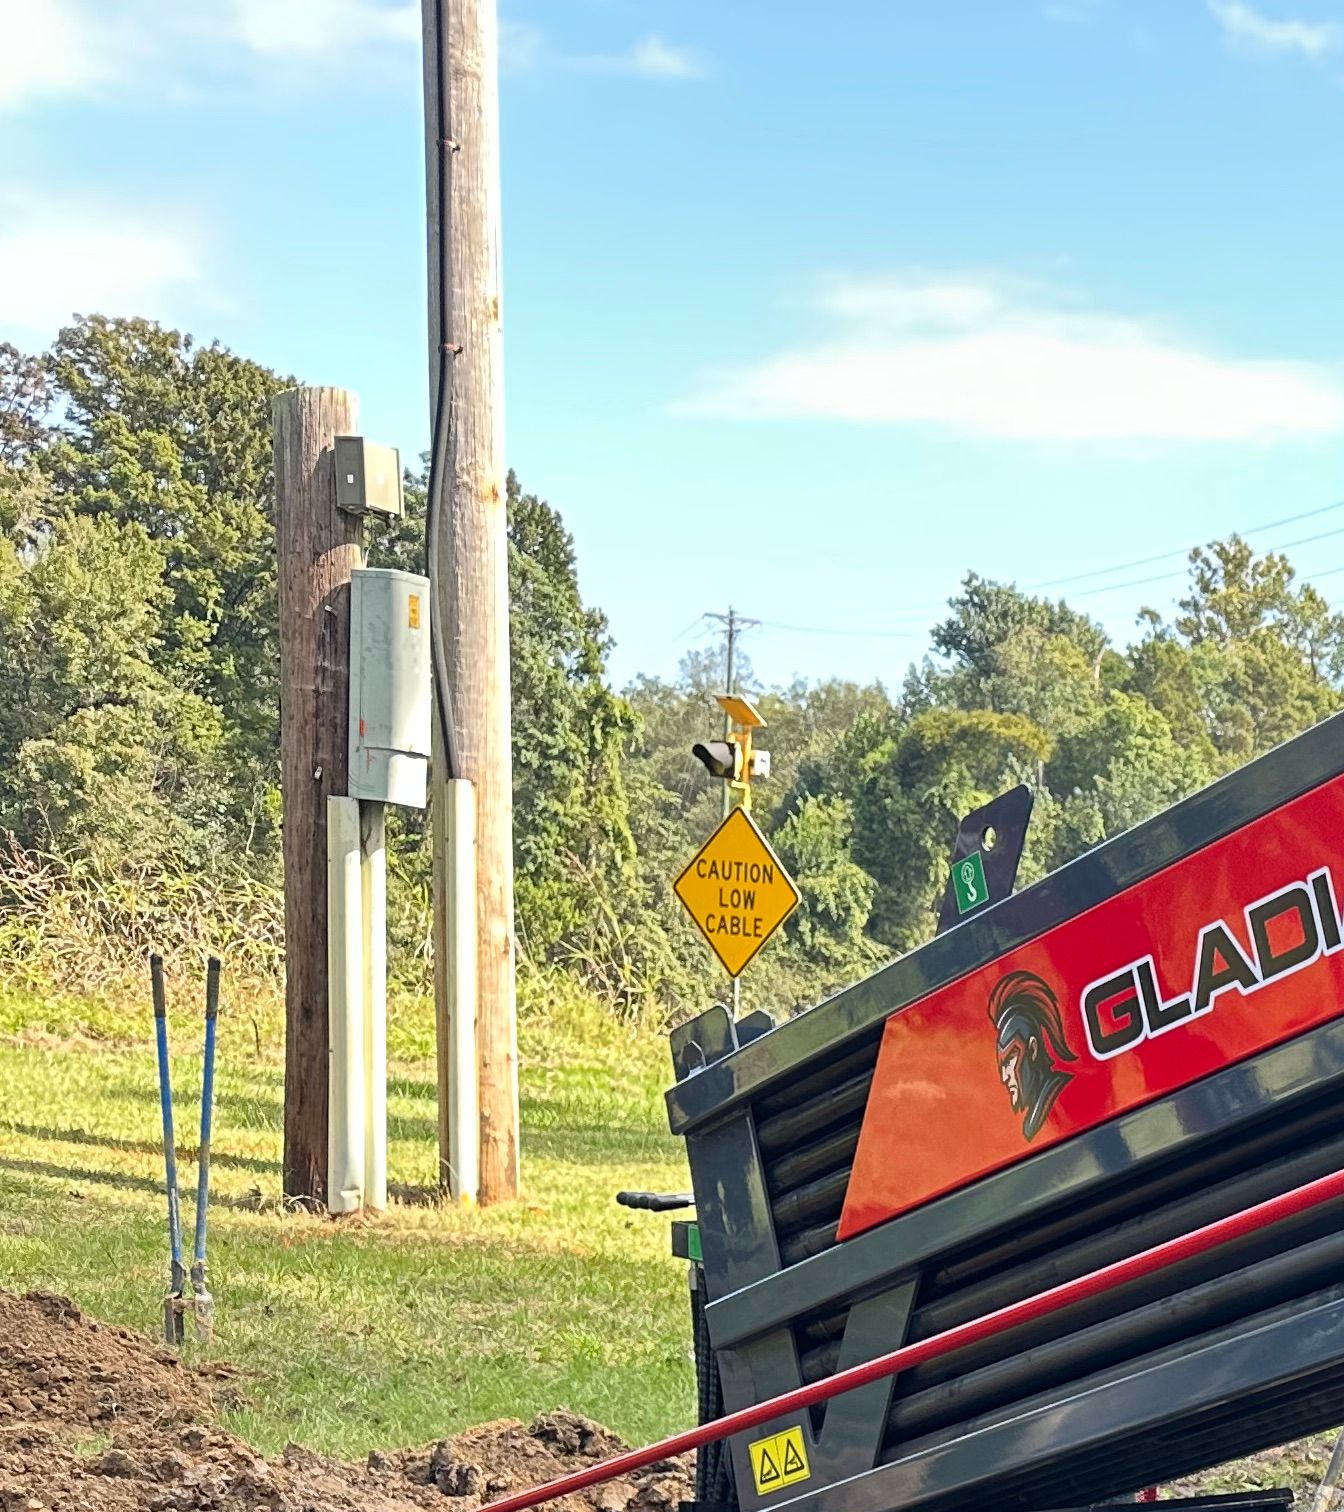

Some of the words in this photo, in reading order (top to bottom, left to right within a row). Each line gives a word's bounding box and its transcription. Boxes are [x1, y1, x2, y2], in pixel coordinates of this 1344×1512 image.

[696, 858, 773, 884] CAUTION
[719, 887, 756, 911] LOW
[705, 913, 763, 938] CABLE
